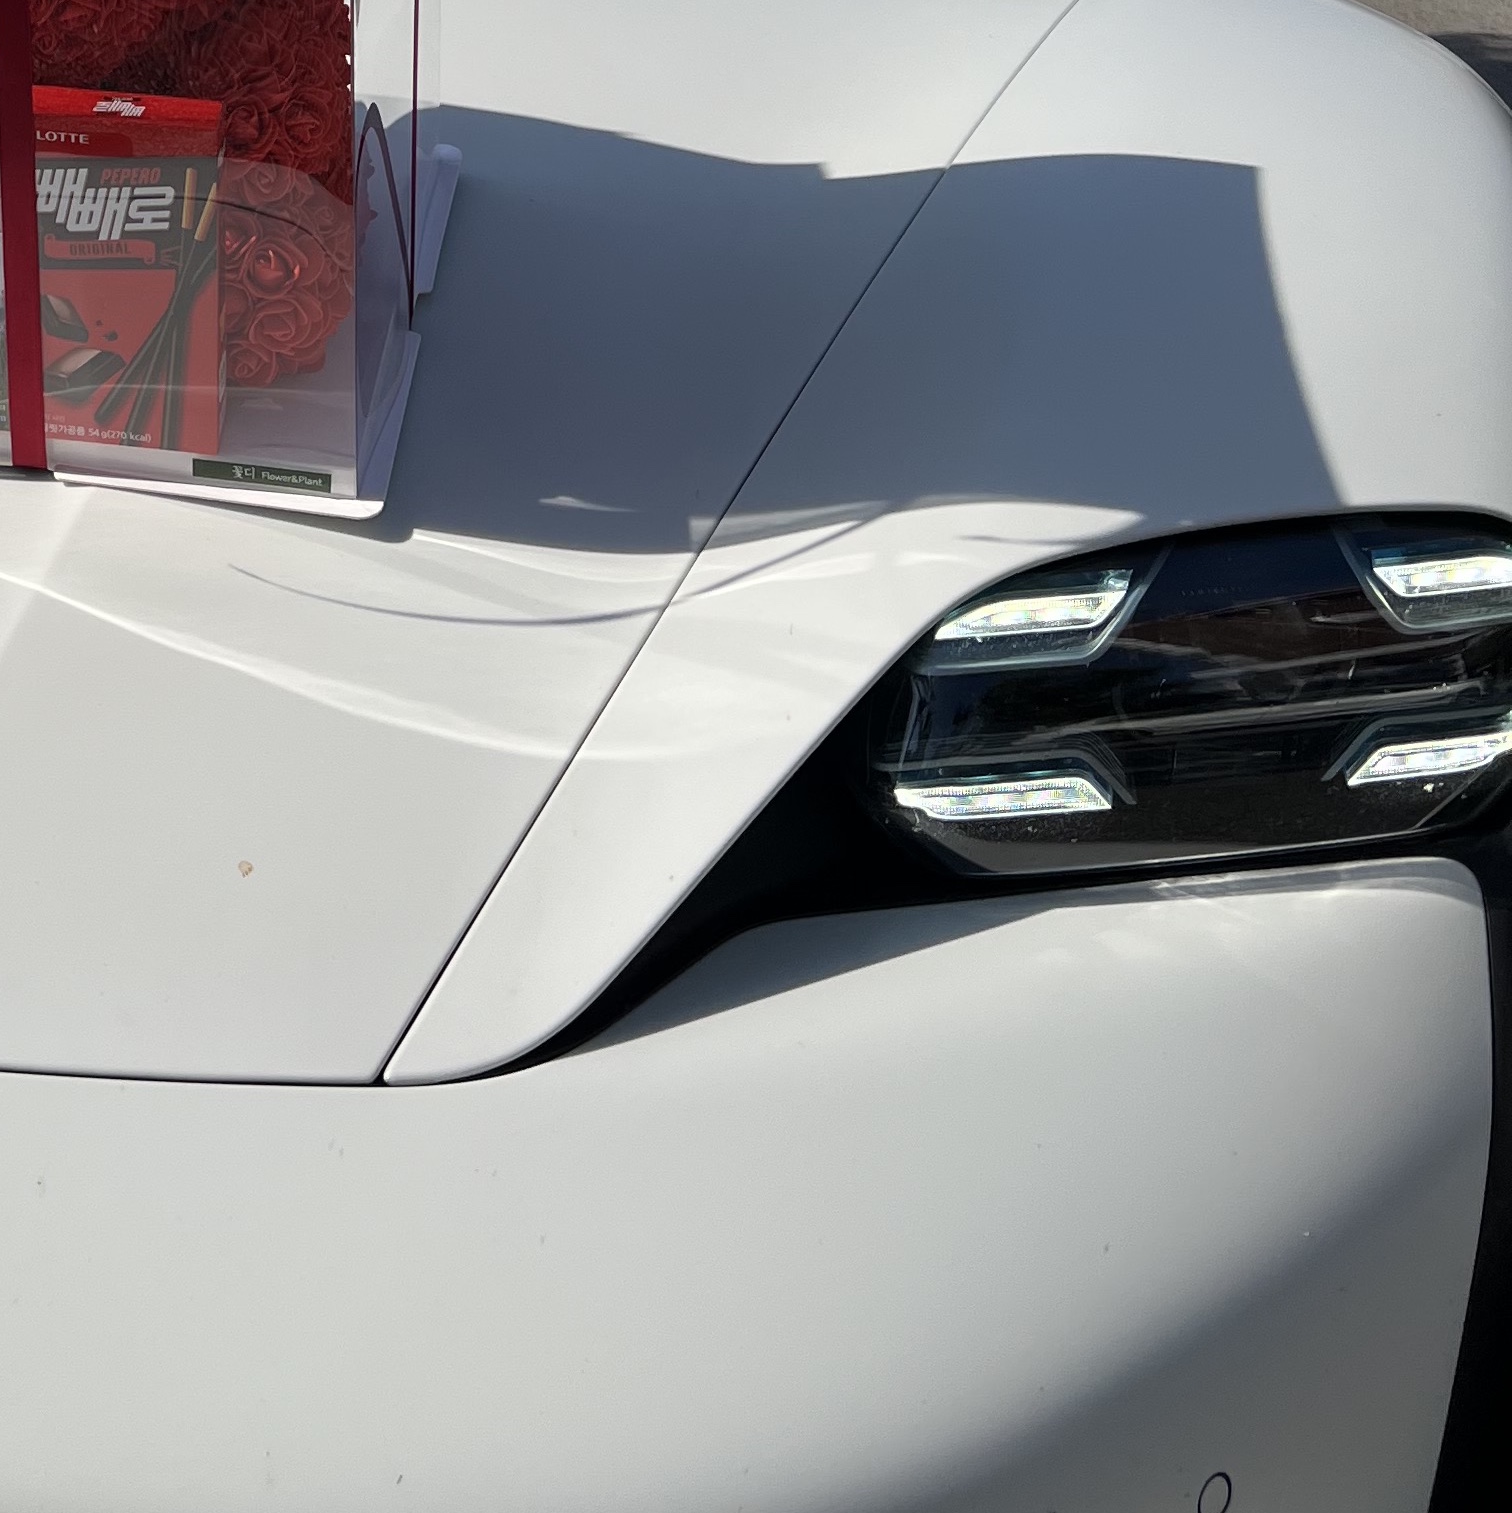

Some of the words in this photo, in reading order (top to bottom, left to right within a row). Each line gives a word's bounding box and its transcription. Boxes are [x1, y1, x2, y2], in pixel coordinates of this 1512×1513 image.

[36, 130, 90, 145] LOTTE
[100, 167, 161, 185] PEPERO
[35, 168, 175, 241] 빼빼로
[69, 241, 131, 256] ORIGINAL
[231, 464, 256, 480] 꽃디
[261, 470, 323, 487] Flower&Plant
